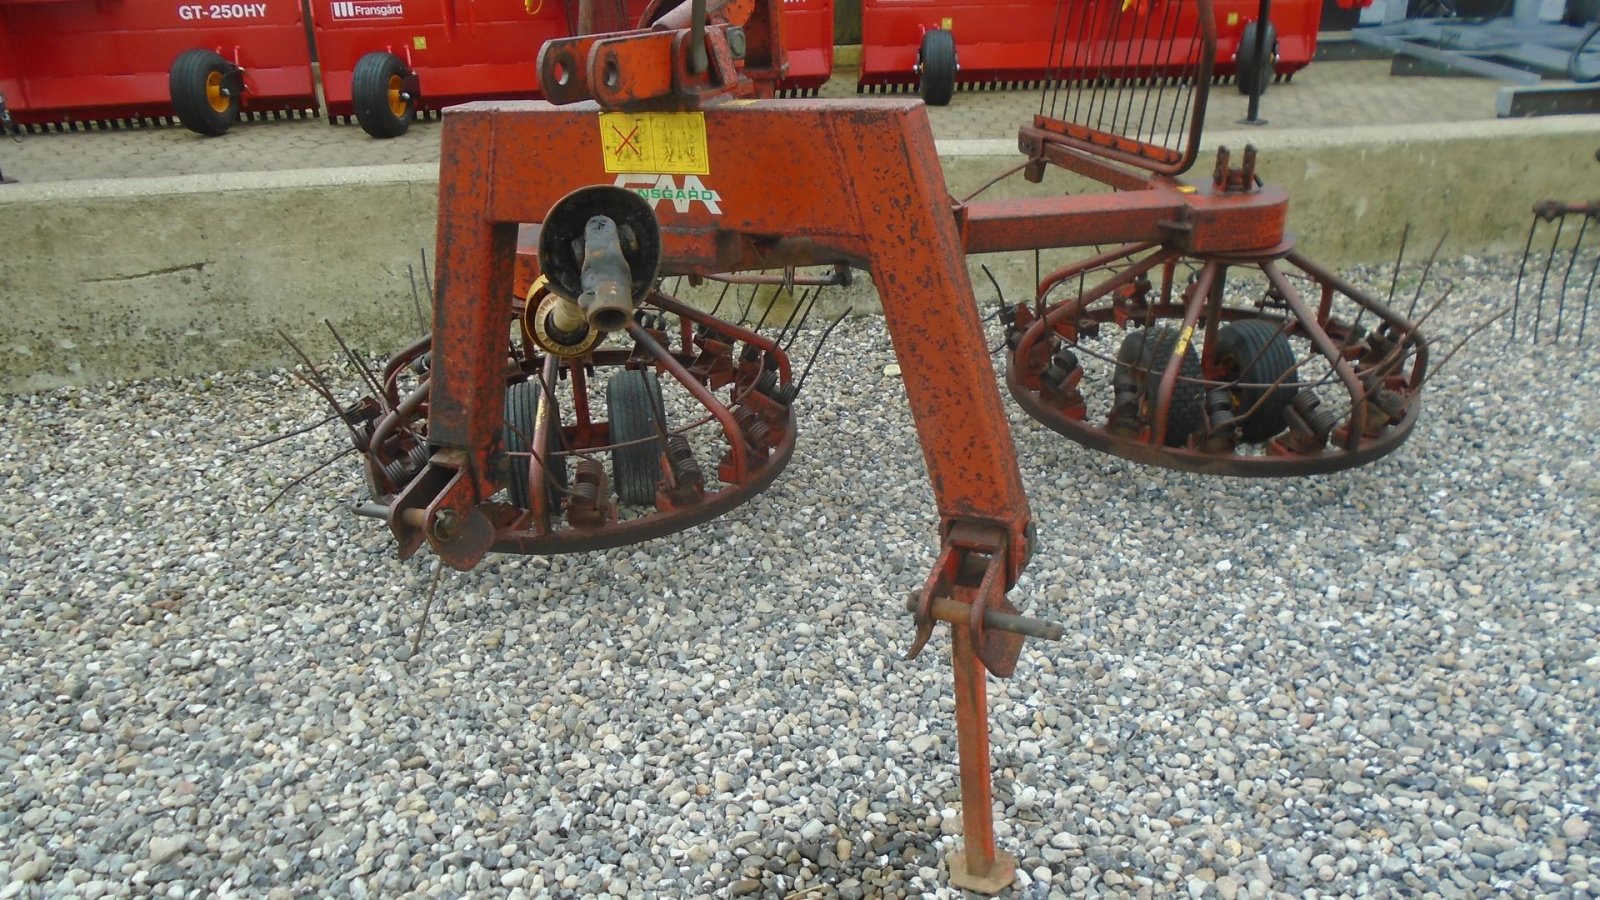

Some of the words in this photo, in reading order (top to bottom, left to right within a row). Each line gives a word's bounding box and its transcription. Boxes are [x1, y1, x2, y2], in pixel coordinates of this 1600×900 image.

[178, 4, 266, 20] GT-250HY
[354, 4, 403, 16] Fransgård
[637, 188, 713, 201] NSGARD
